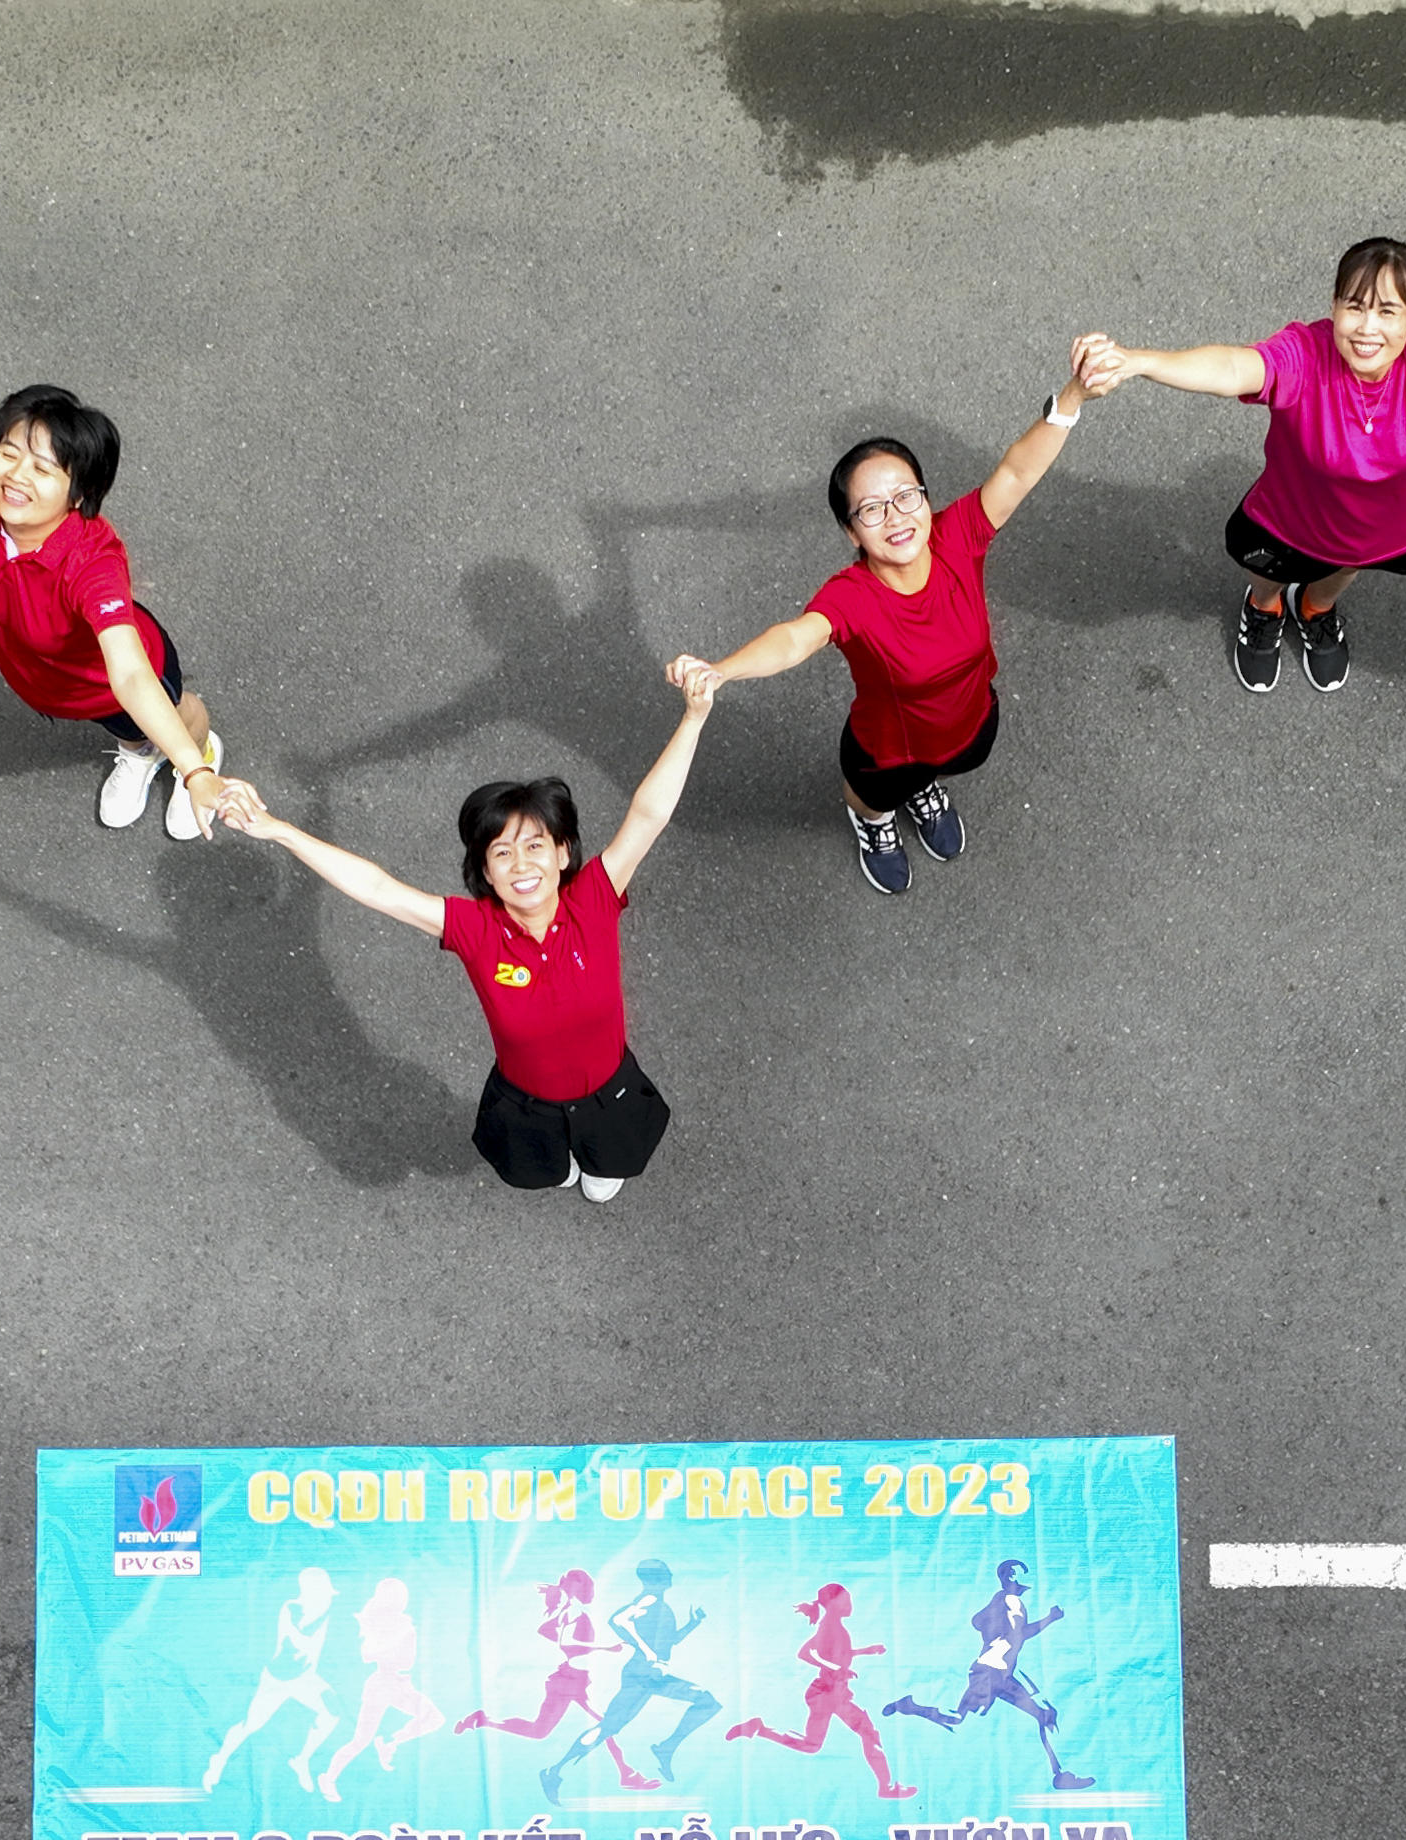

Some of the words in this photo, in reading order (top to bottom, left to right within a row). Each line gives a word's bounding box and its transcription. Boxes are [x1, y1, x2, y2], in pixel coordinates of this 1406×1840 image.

[248, 1470, 425, 1528] CQĐH
[449, 1470, 577, 1522] RUN
[600, 1466, 843, 1521] UPRACE
[864, 1463, 1031, 1518] 2023
